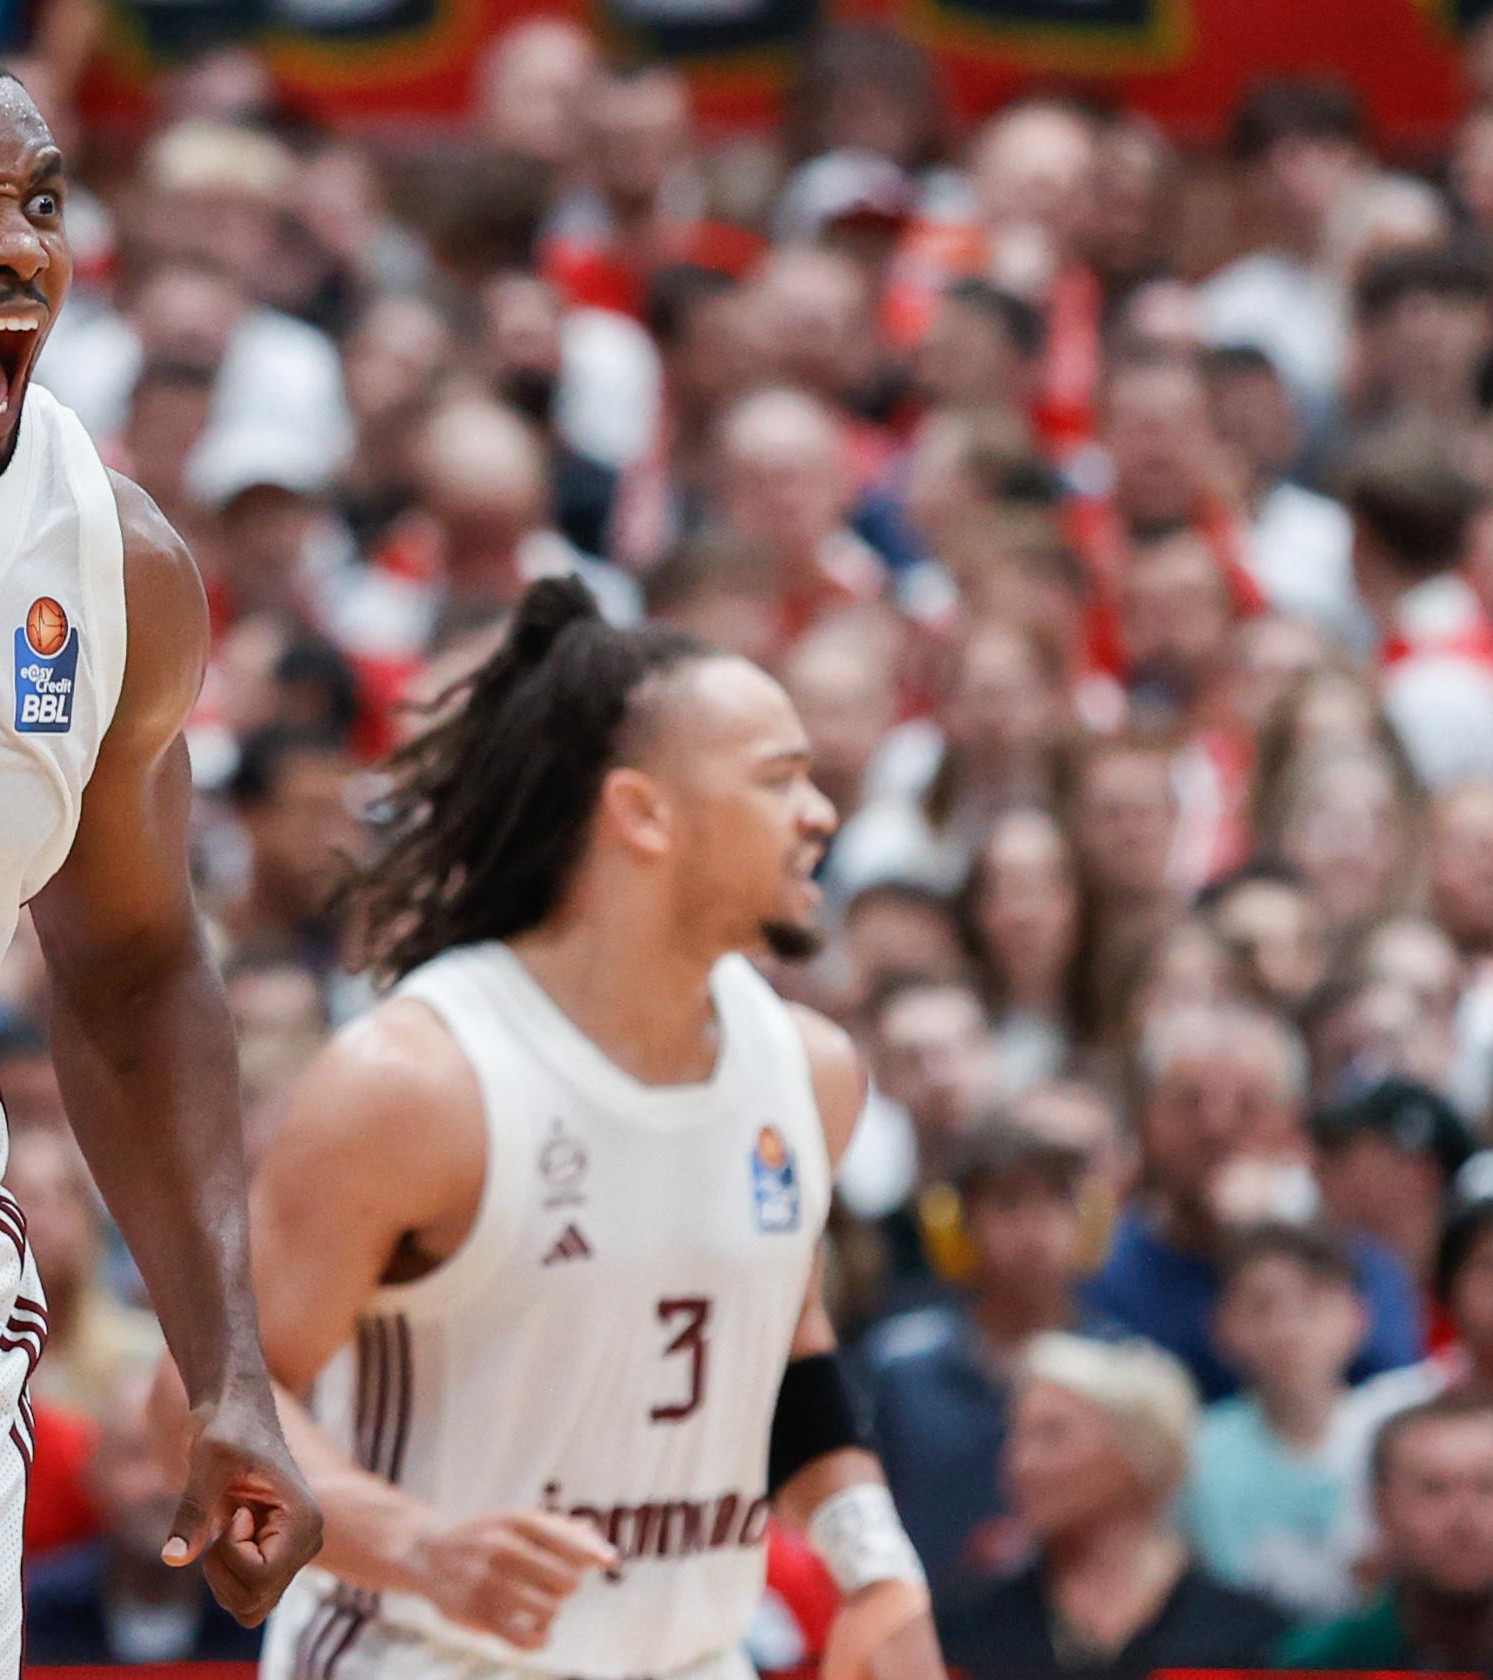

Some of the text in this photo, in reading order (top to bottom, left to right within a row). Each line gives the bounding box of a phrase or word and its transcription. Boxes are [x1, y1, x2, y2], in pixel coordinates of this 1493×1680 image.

[35, 678, 72, 694] Credit
[21, 693, 69, 724] BBL
[650, 1299, 711, 1424] 3
